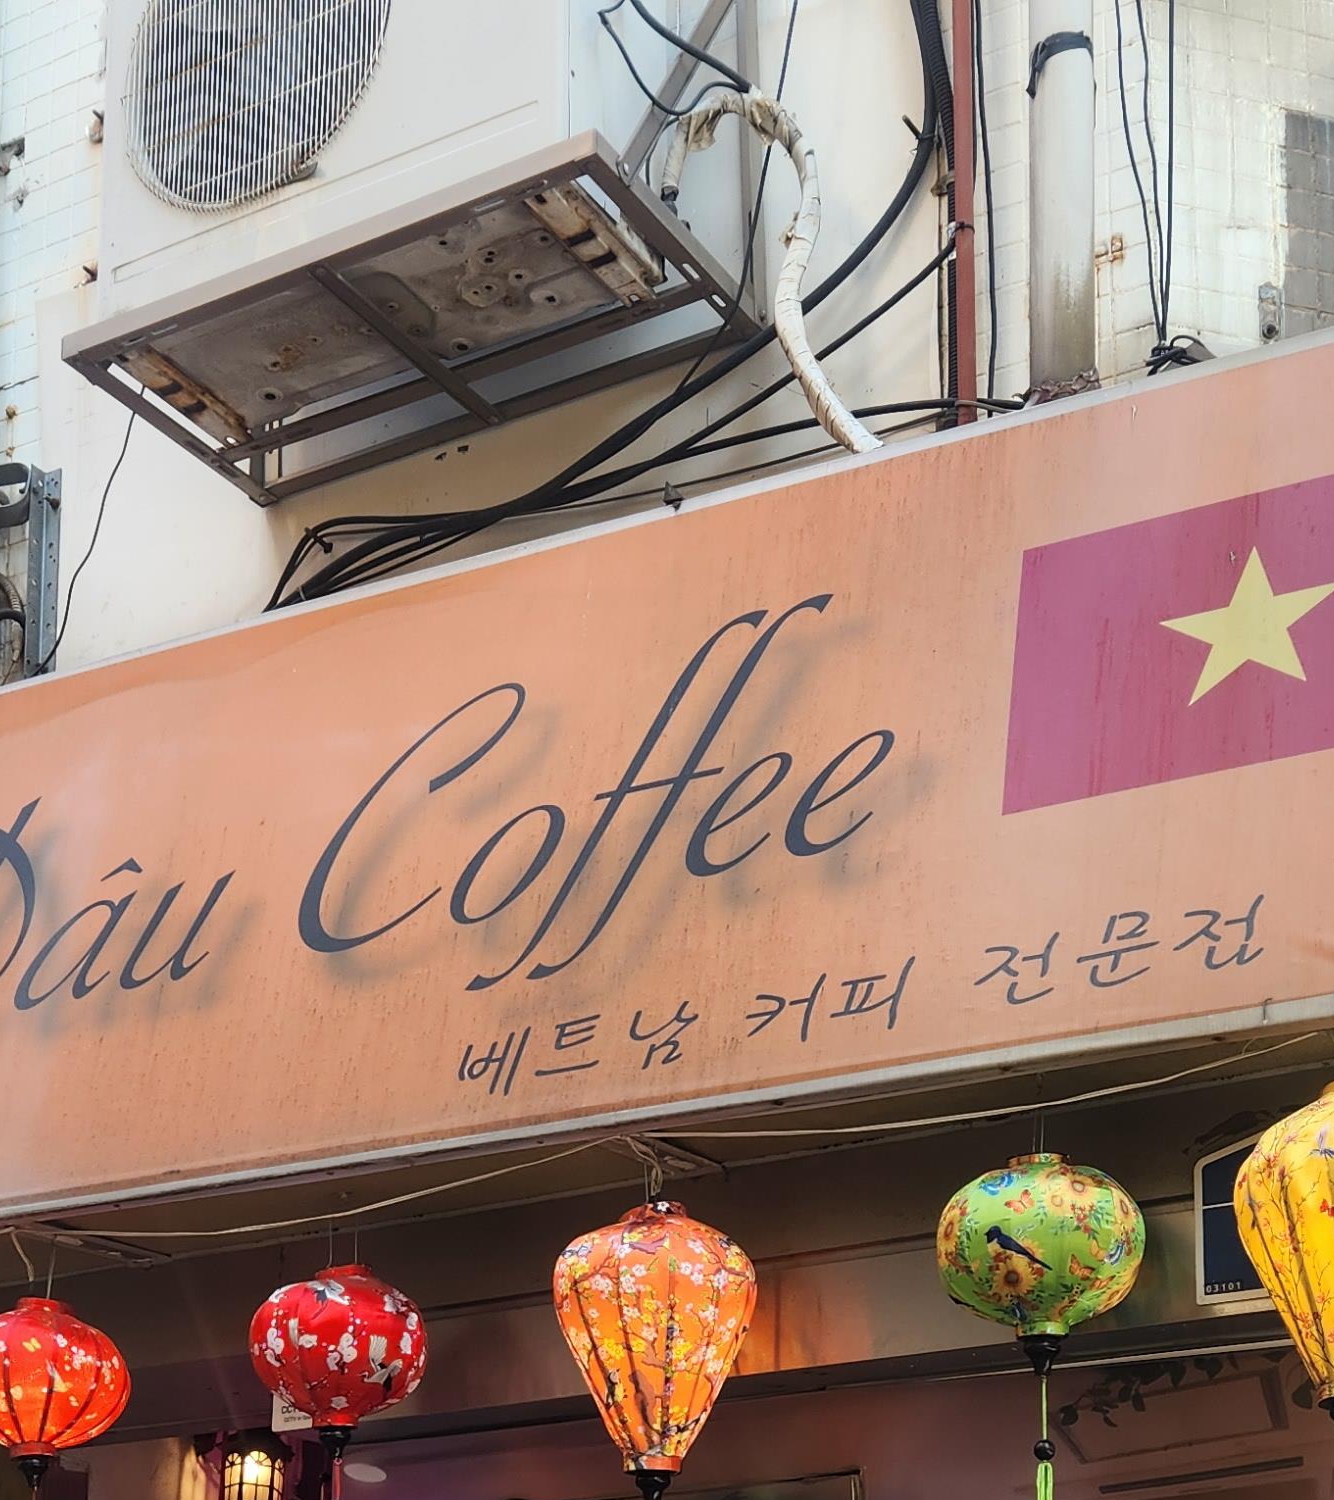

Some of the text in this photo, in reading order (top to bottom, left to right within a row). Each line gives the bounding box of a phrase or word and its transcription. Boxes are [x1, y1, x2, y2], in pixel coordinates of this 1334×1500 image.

[297, 592, 895, 992] Coffee
[458, 893, 1267, 1097] 베트남 커피 전문점
[1205, 1281, 1242, 1293] 03101
